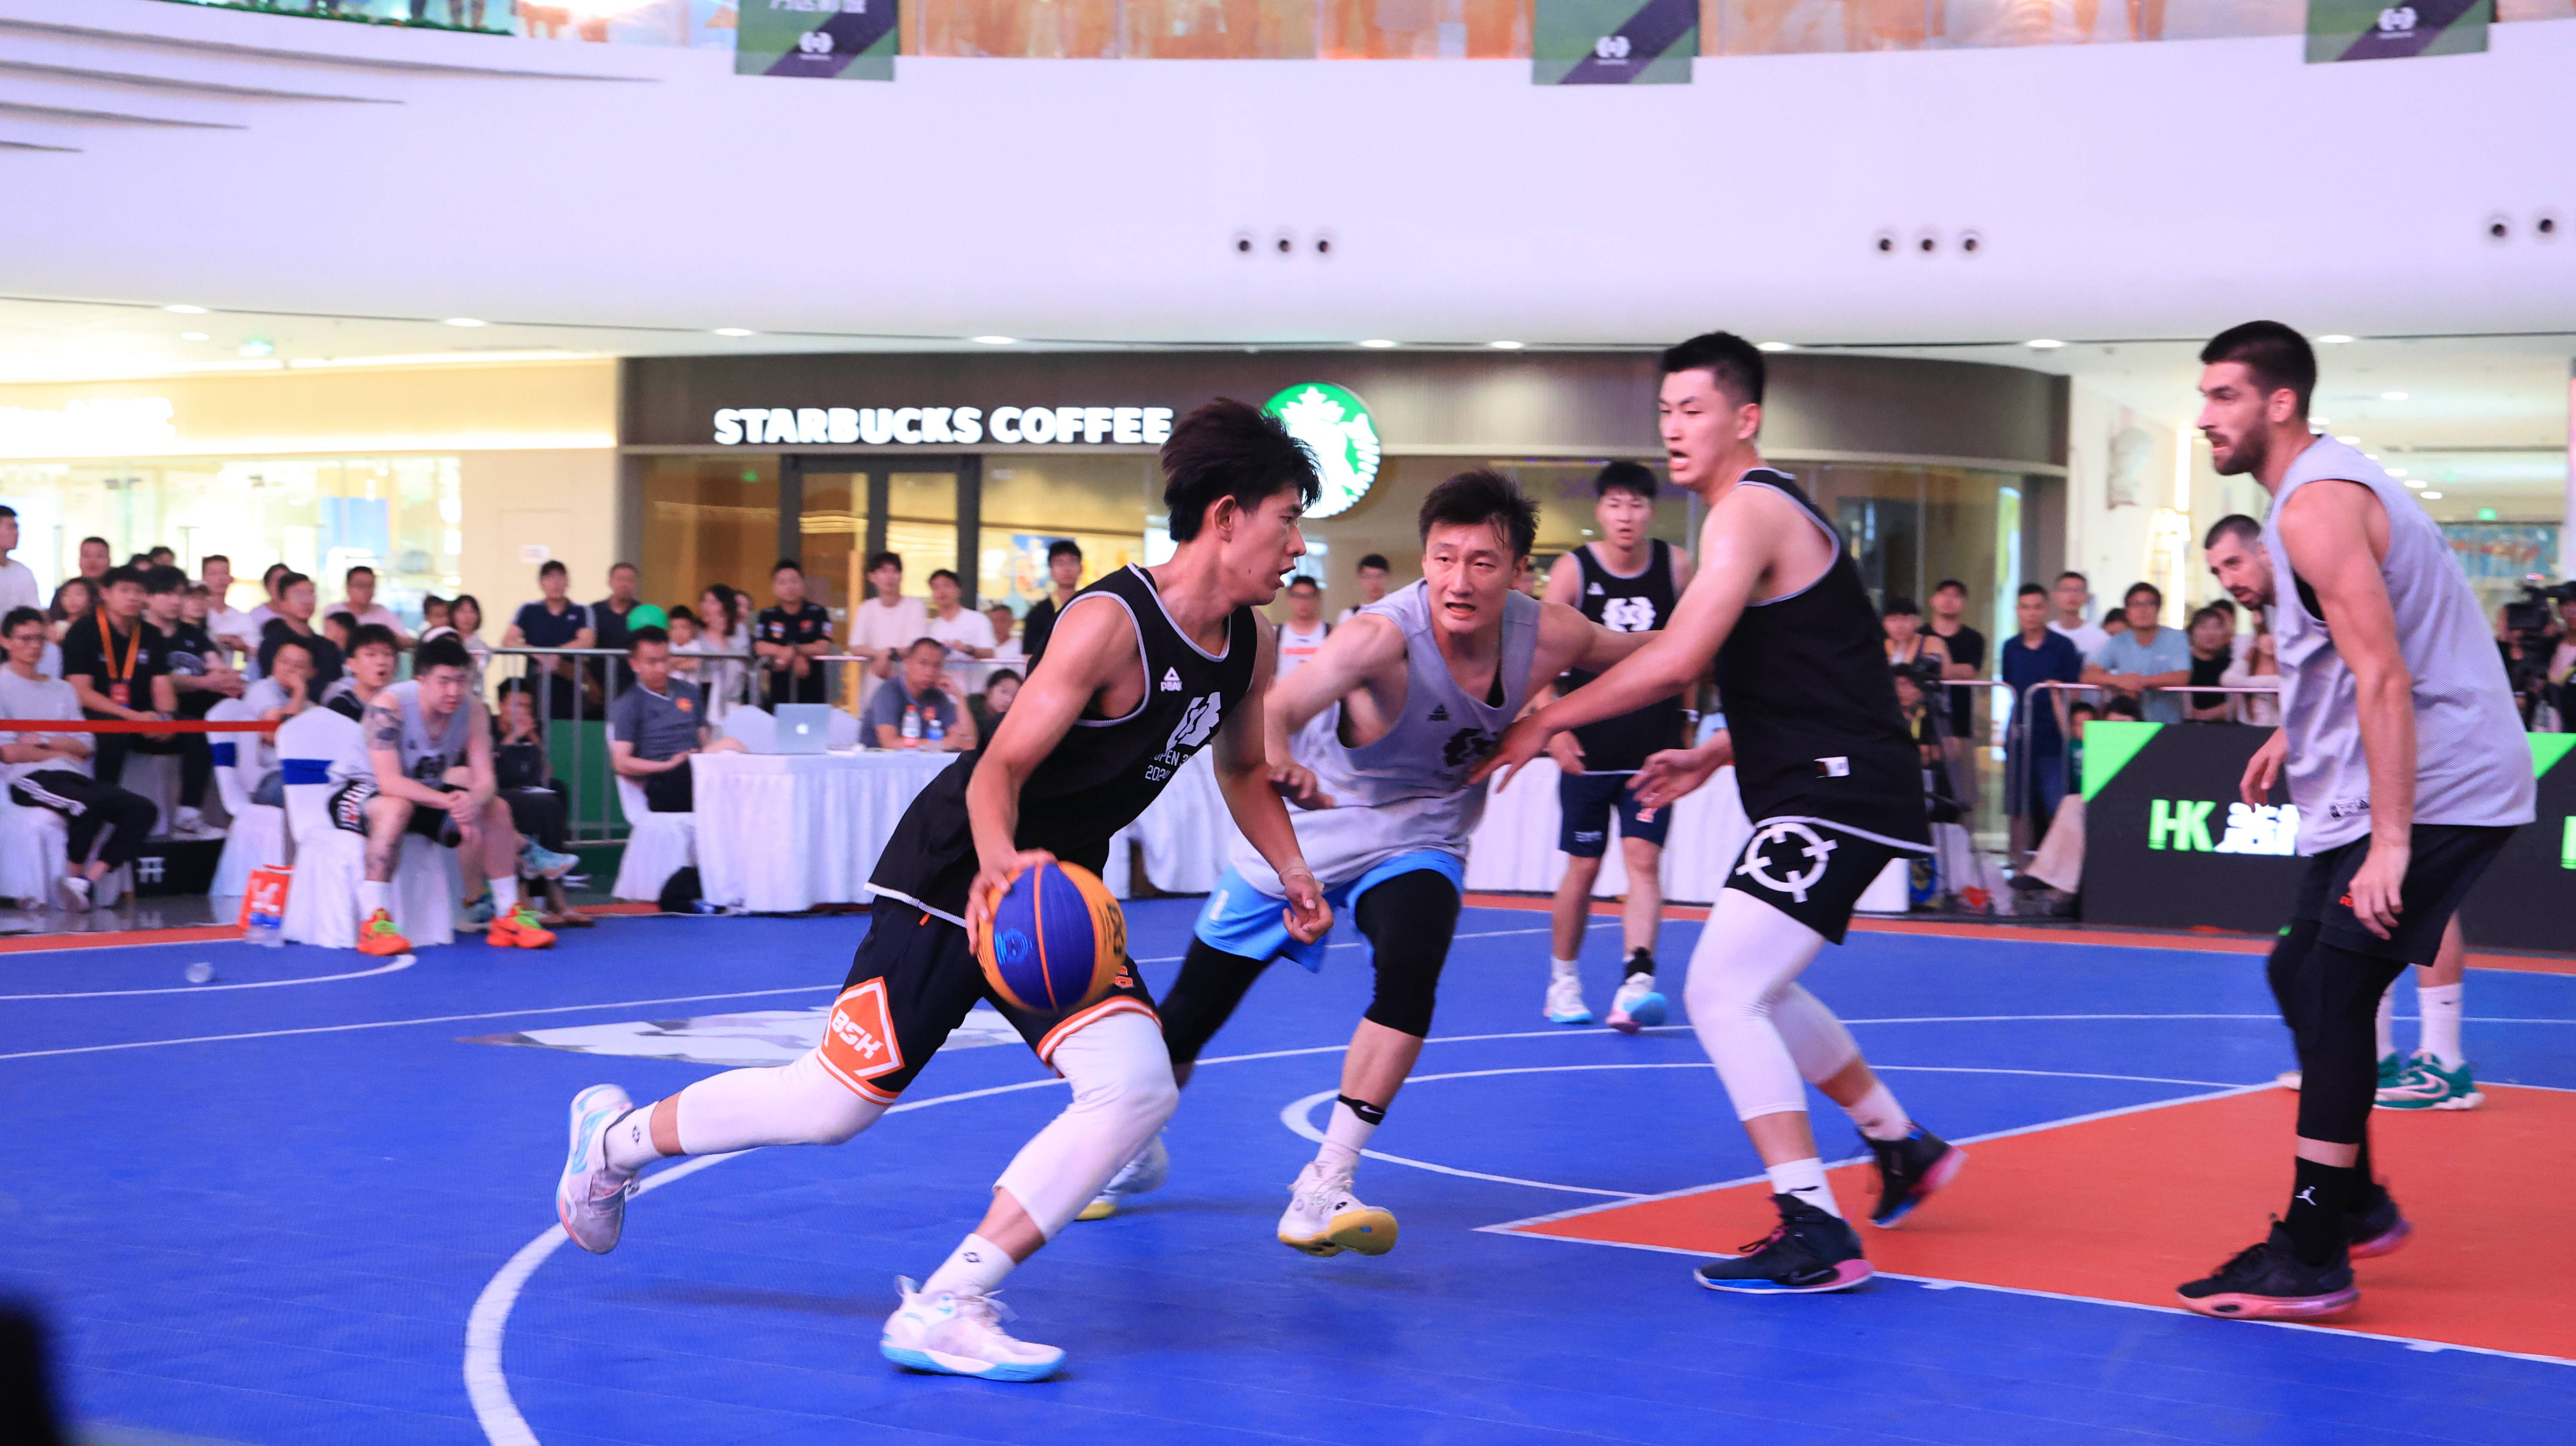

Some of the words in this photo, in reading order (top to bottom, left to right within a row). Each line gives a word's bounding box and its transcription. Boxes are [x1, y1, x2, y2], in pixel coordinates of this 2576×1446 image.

[714, 407, 983, 445] STARBUCKS
[989, 406, 1174, 444] COFFEE
[2148, 799, 2217, 852] HK
[831, 1007, 884, 1060] BSK
